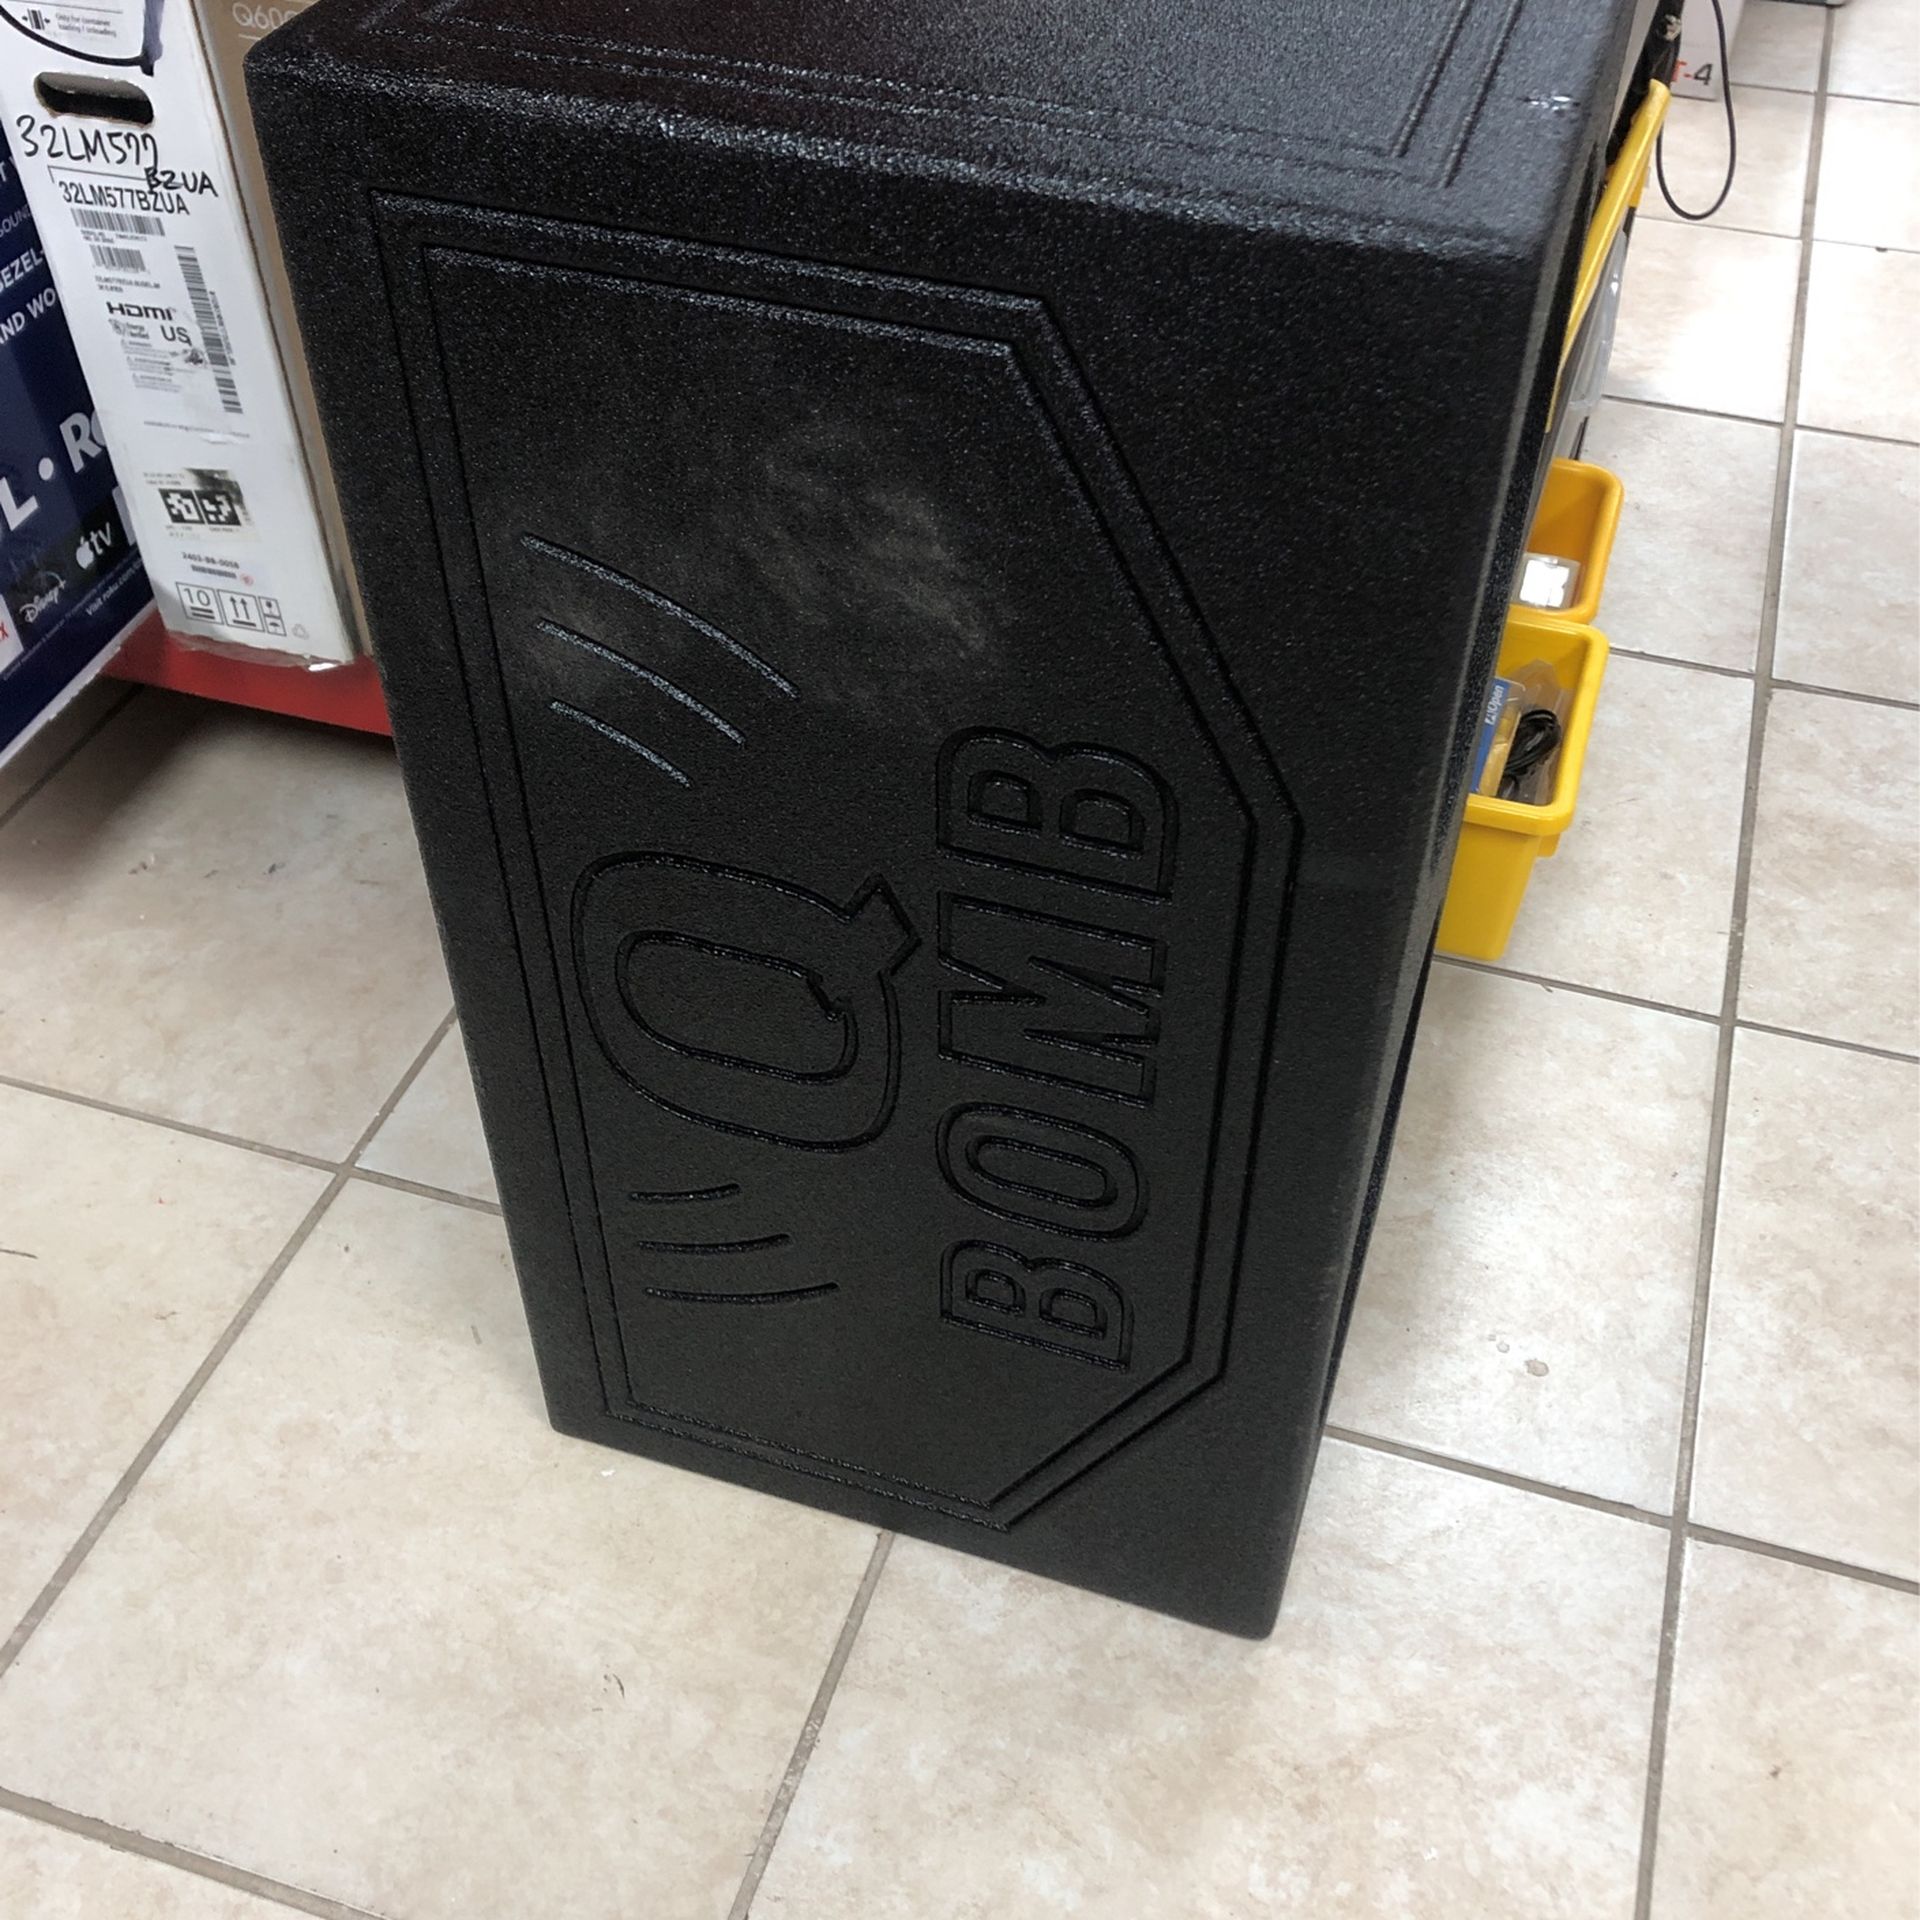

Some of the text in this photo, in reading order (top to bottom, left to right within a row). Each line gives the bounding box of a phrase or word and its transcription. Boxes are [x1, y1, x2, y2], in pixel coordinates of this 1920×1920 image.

[16, 115, 159, 167] 32LM577
[59, 181, 190, 215] 32LM577BZUA
[160, 325, 192, 347] US
[90, 521, 112, 556] tv
[183, 587, 211, 607] 10
[569, 849, 922, 1155] Q
[935, 725, 1180, 1373] BOMB
